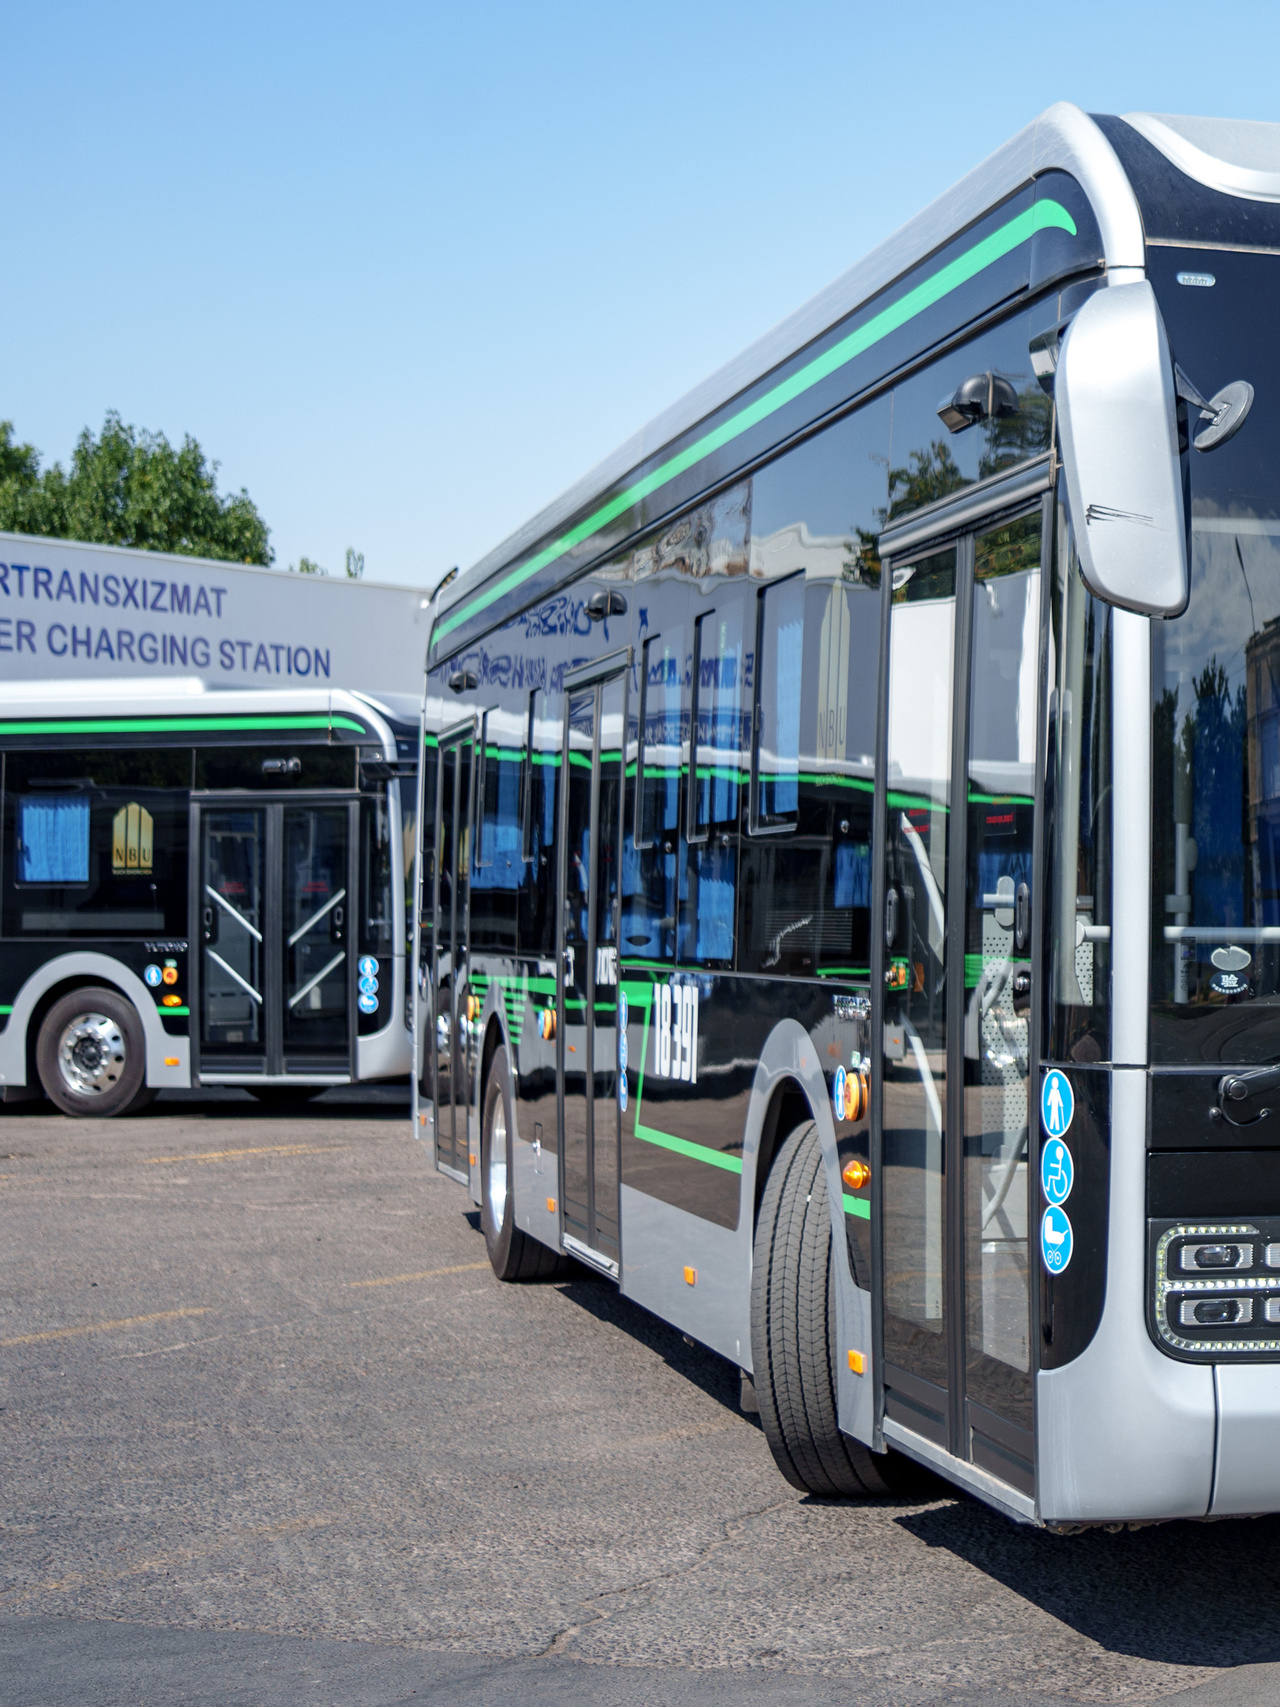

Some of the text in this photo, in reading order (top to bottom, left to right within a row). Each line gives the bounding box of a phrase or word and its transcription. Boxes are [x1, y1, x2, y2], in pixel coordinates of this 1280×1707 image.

[46, 623, 211, 668] CHARGING
[219, 639, 331, 678] STATION
[818, 706, 846, 750] NBU
[115, 848, 151, 862] NBU
